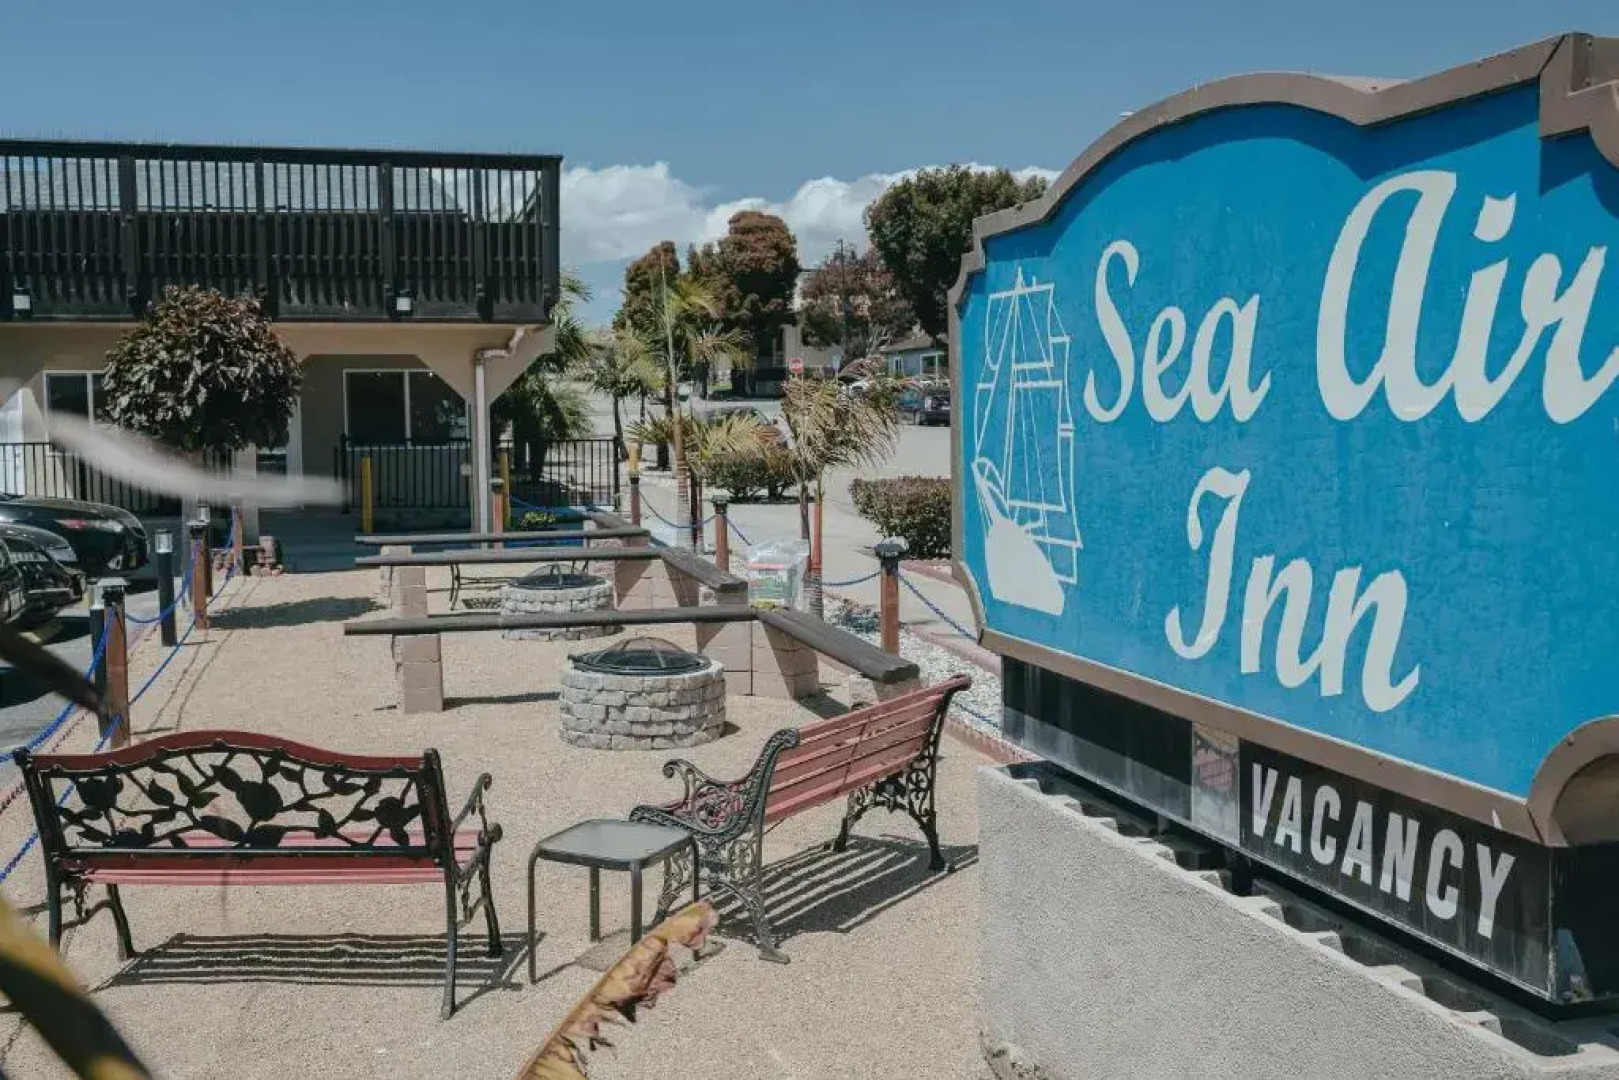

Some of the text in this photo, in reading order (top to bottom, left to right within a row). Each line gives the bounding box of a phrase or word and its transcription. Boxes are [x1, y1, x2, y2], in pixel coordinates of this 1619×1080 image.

[1083, 170, 1619, 424] Sea Air
[1165, 467, 1420, 712] Inn
[1252, 762, 1517, 939] VACANCY
